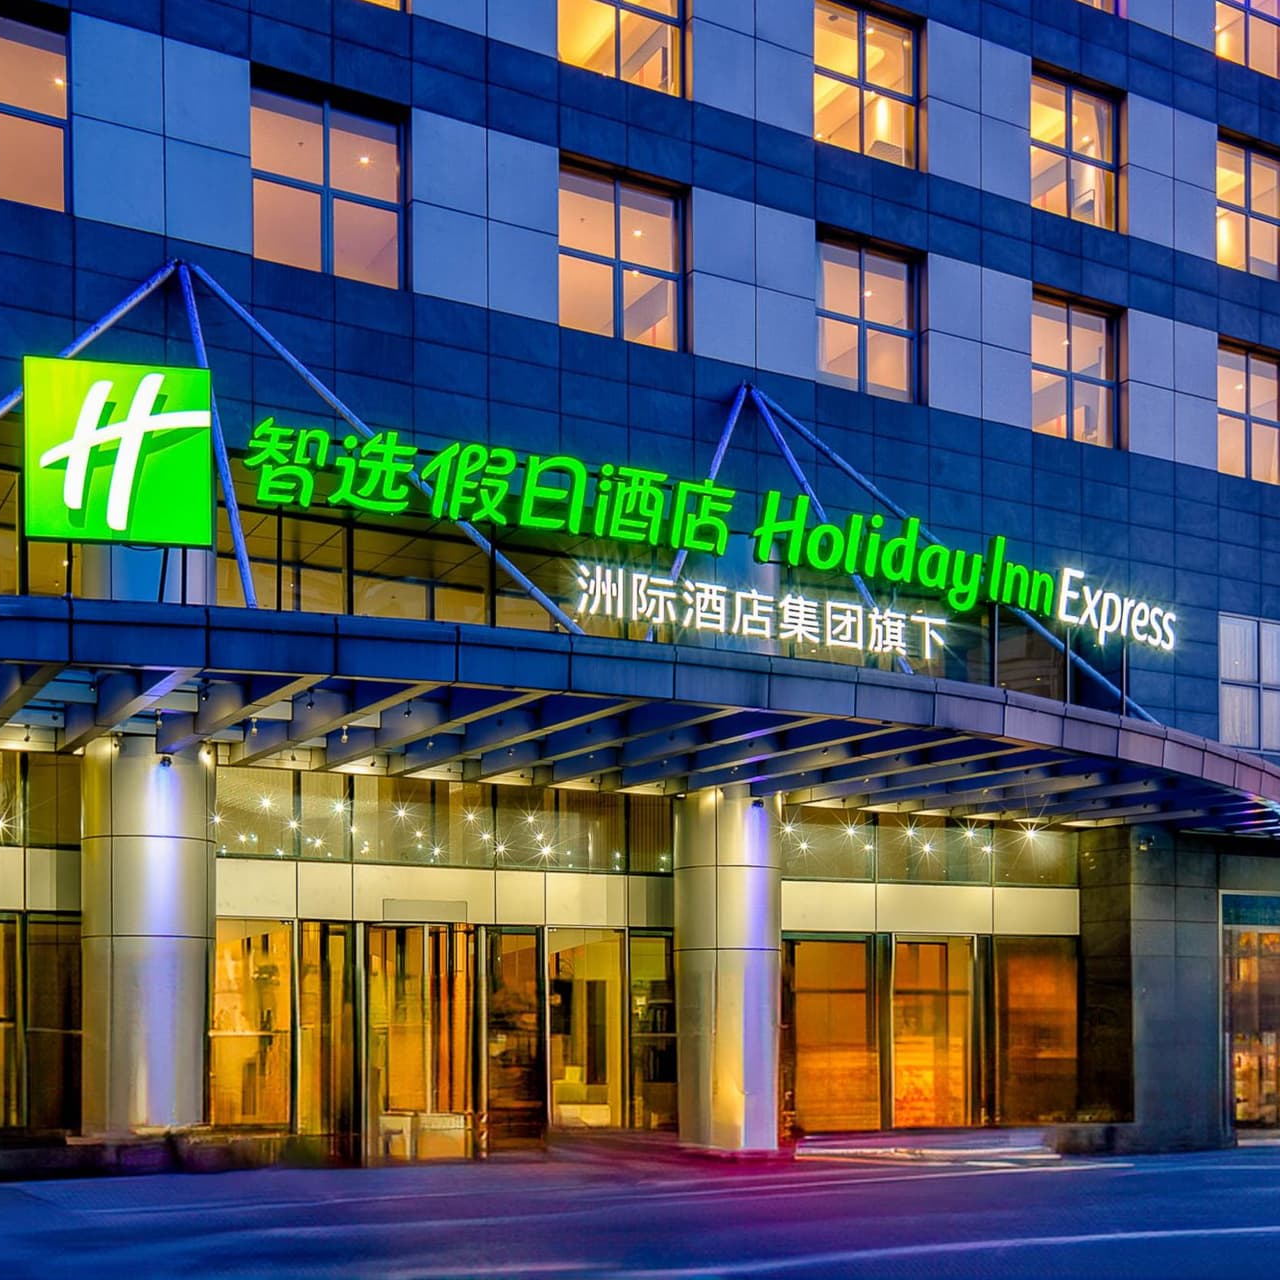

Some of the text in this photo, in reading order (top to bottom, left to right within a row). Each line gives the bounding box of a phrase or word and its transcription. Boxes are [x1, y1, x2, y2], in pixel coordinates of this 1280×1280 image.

[243, 416, 1177, 652] 智选假日酒店 Holiday Inn Express
[576, 563, 948, 661] 洲际酒店集团旗下
